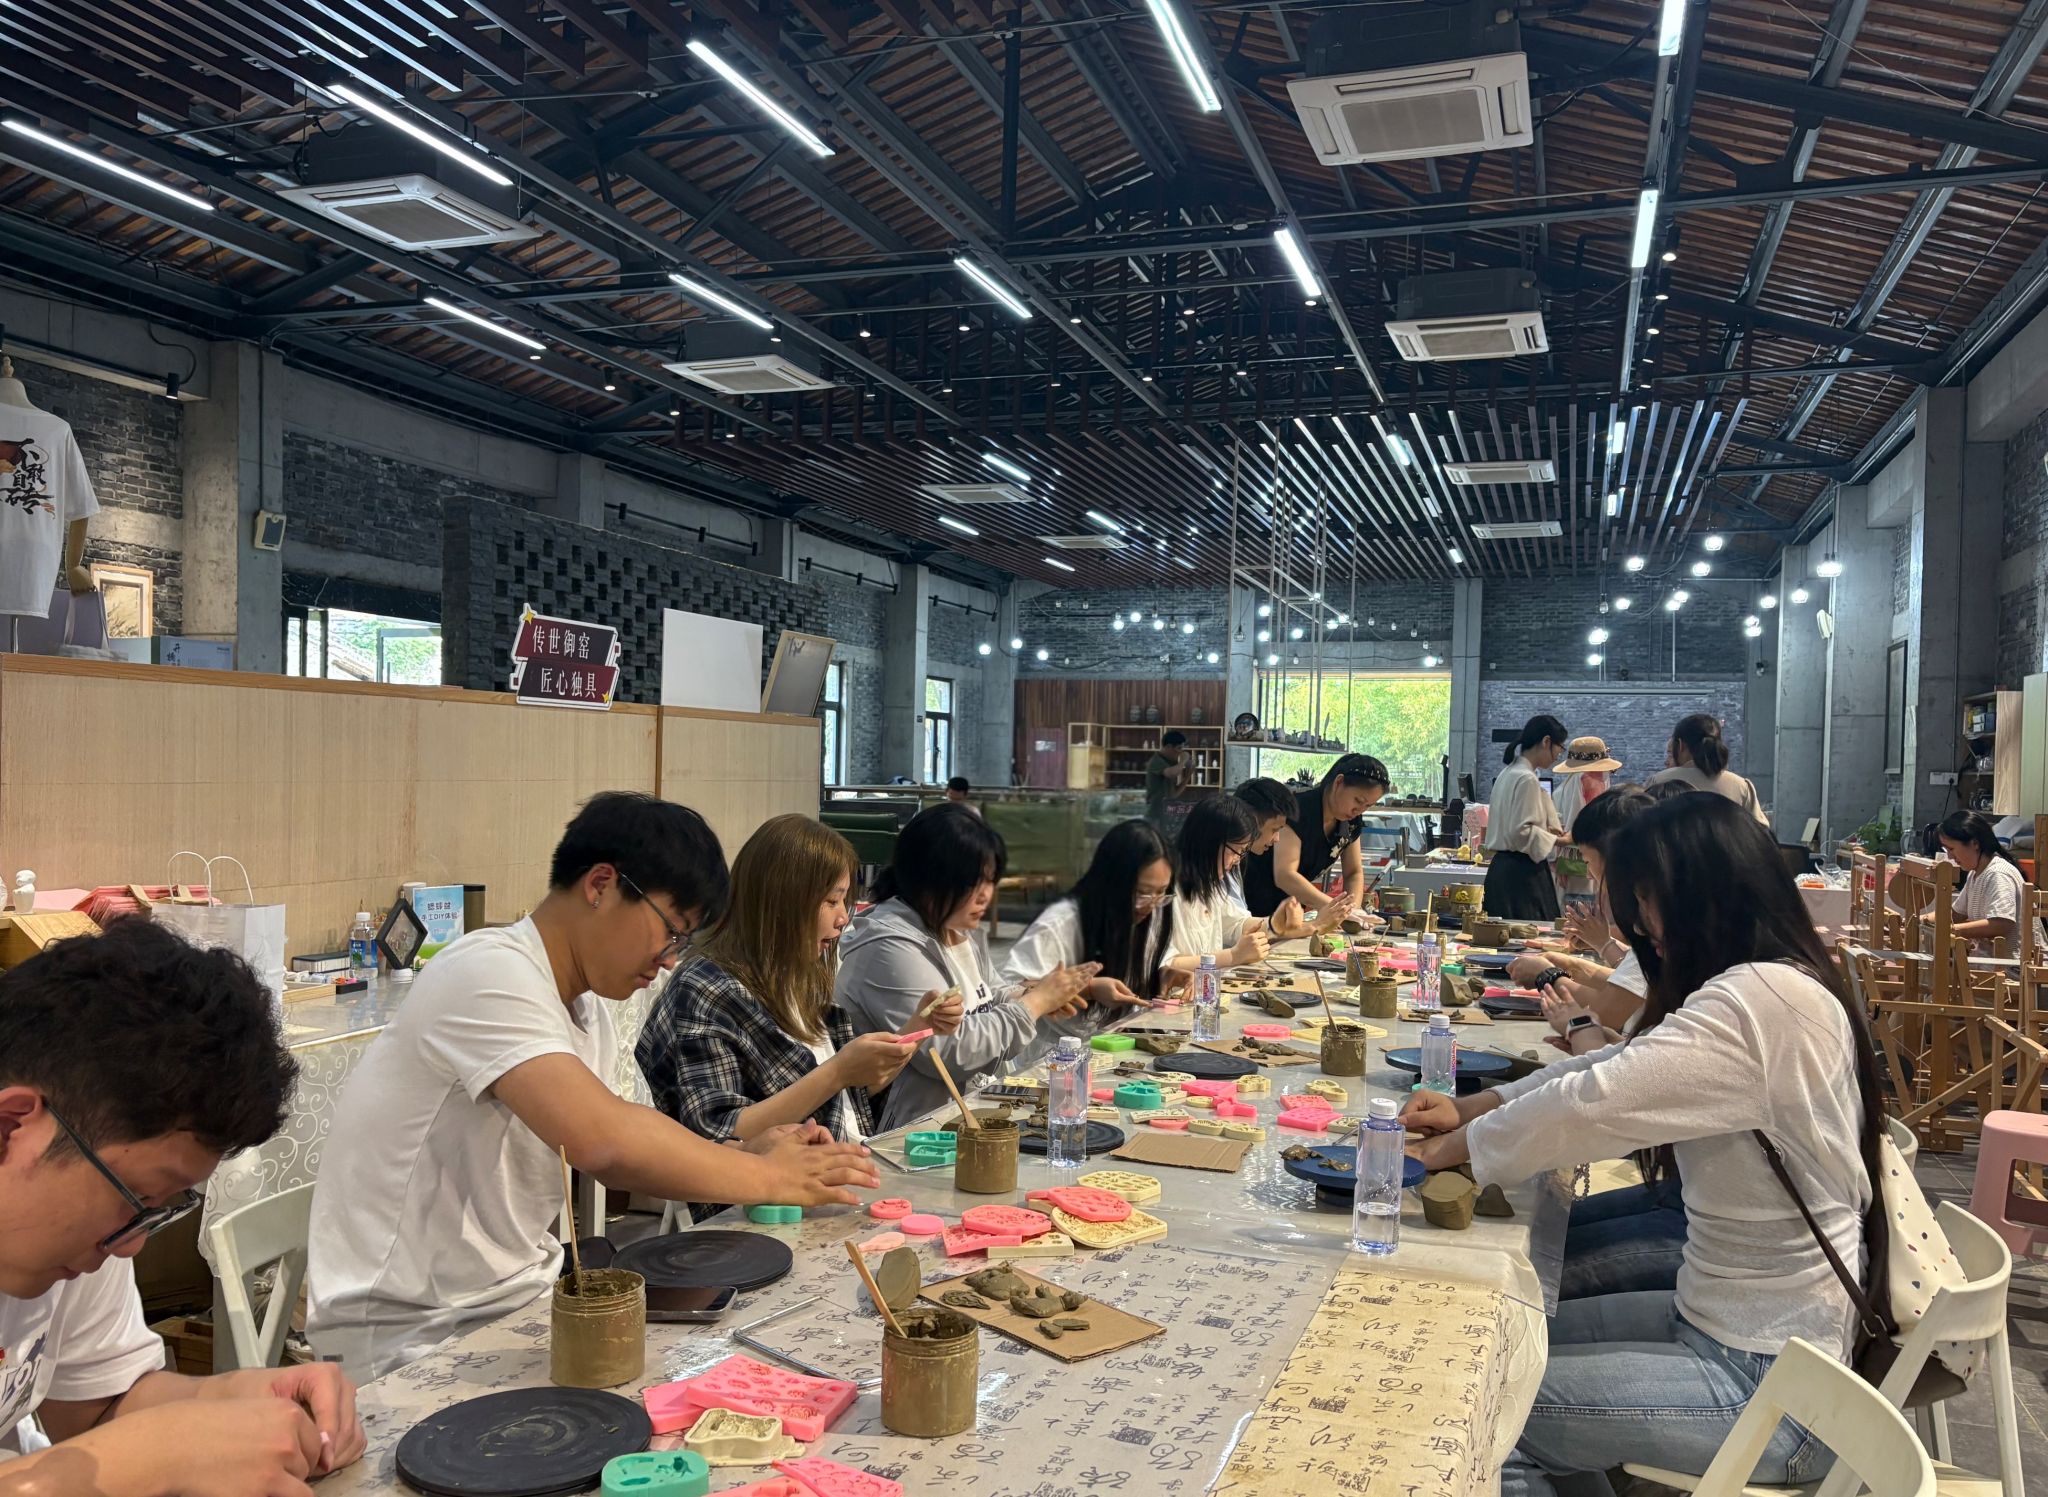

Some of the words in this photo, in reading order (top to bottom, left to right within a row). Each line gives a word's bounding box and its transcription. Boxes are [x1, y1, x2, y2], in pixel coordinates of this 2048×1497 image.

[533, 625, 591, 660] 传世御窑
[540, 667, 597, 699] 匠心独具
